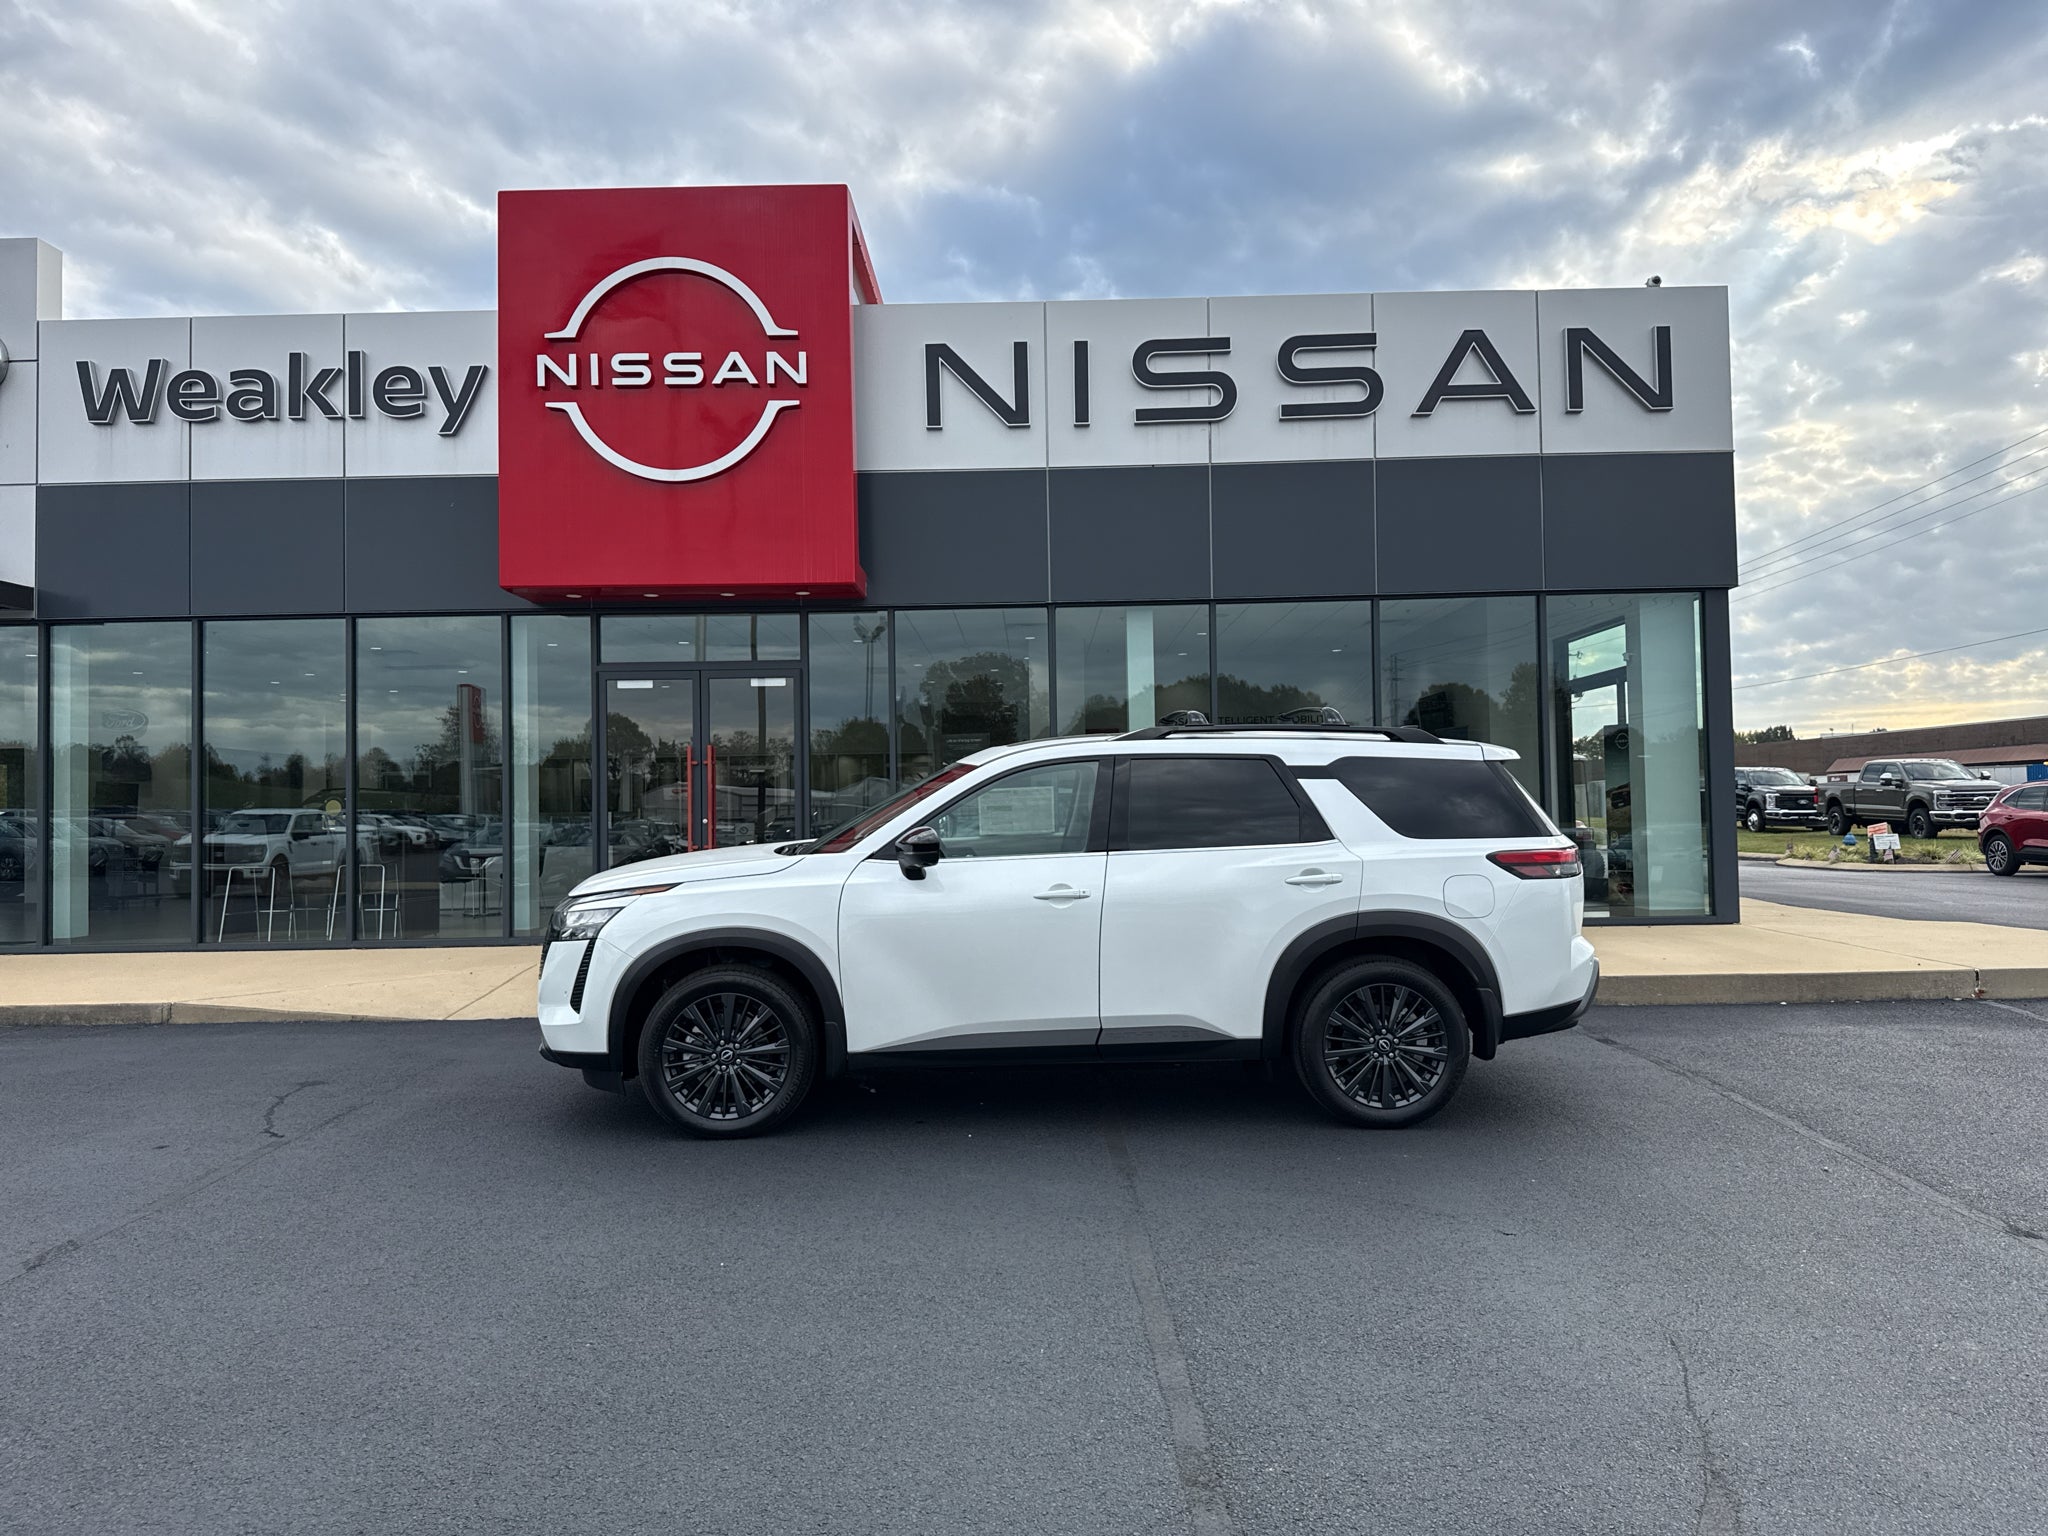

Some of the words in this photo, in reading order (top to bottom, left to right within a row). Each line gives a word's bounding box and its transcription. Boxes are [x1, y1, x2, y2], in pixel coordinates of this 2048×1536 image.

[75, 350, 489, 436] Weakley
[536, 351, 808, 387] NISSAN
[925, 325, 1673, 429] NISSAN
[1216, 715, 1275, 725] TELLIGENT
